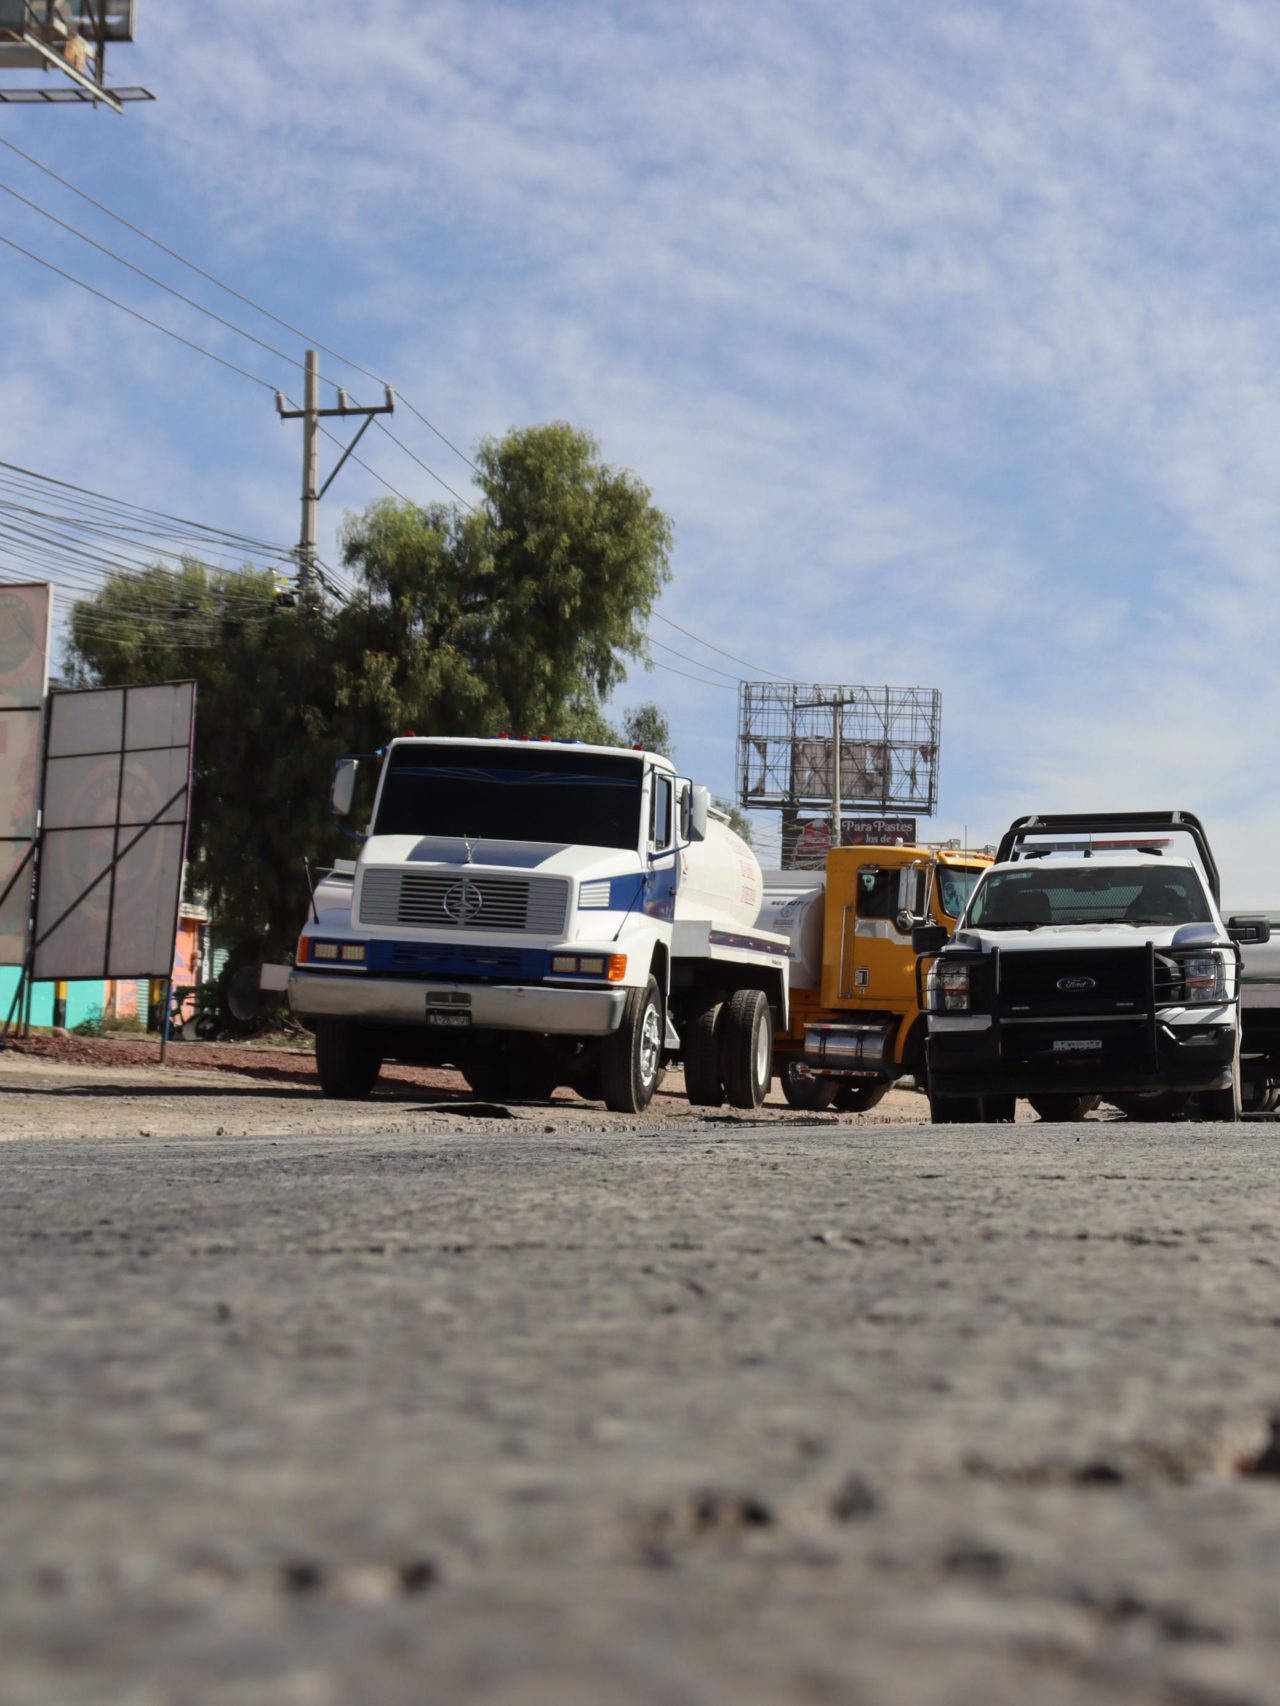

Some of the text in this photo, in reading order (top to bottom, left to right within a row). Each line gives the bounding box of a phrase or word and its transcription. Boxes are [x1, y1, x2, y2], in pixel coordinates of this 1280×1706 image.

[841, 820, 913, 833] Para Pastes
[865, 833, 892, 843] los de
[1065, 979, 1088, 989] Ford
